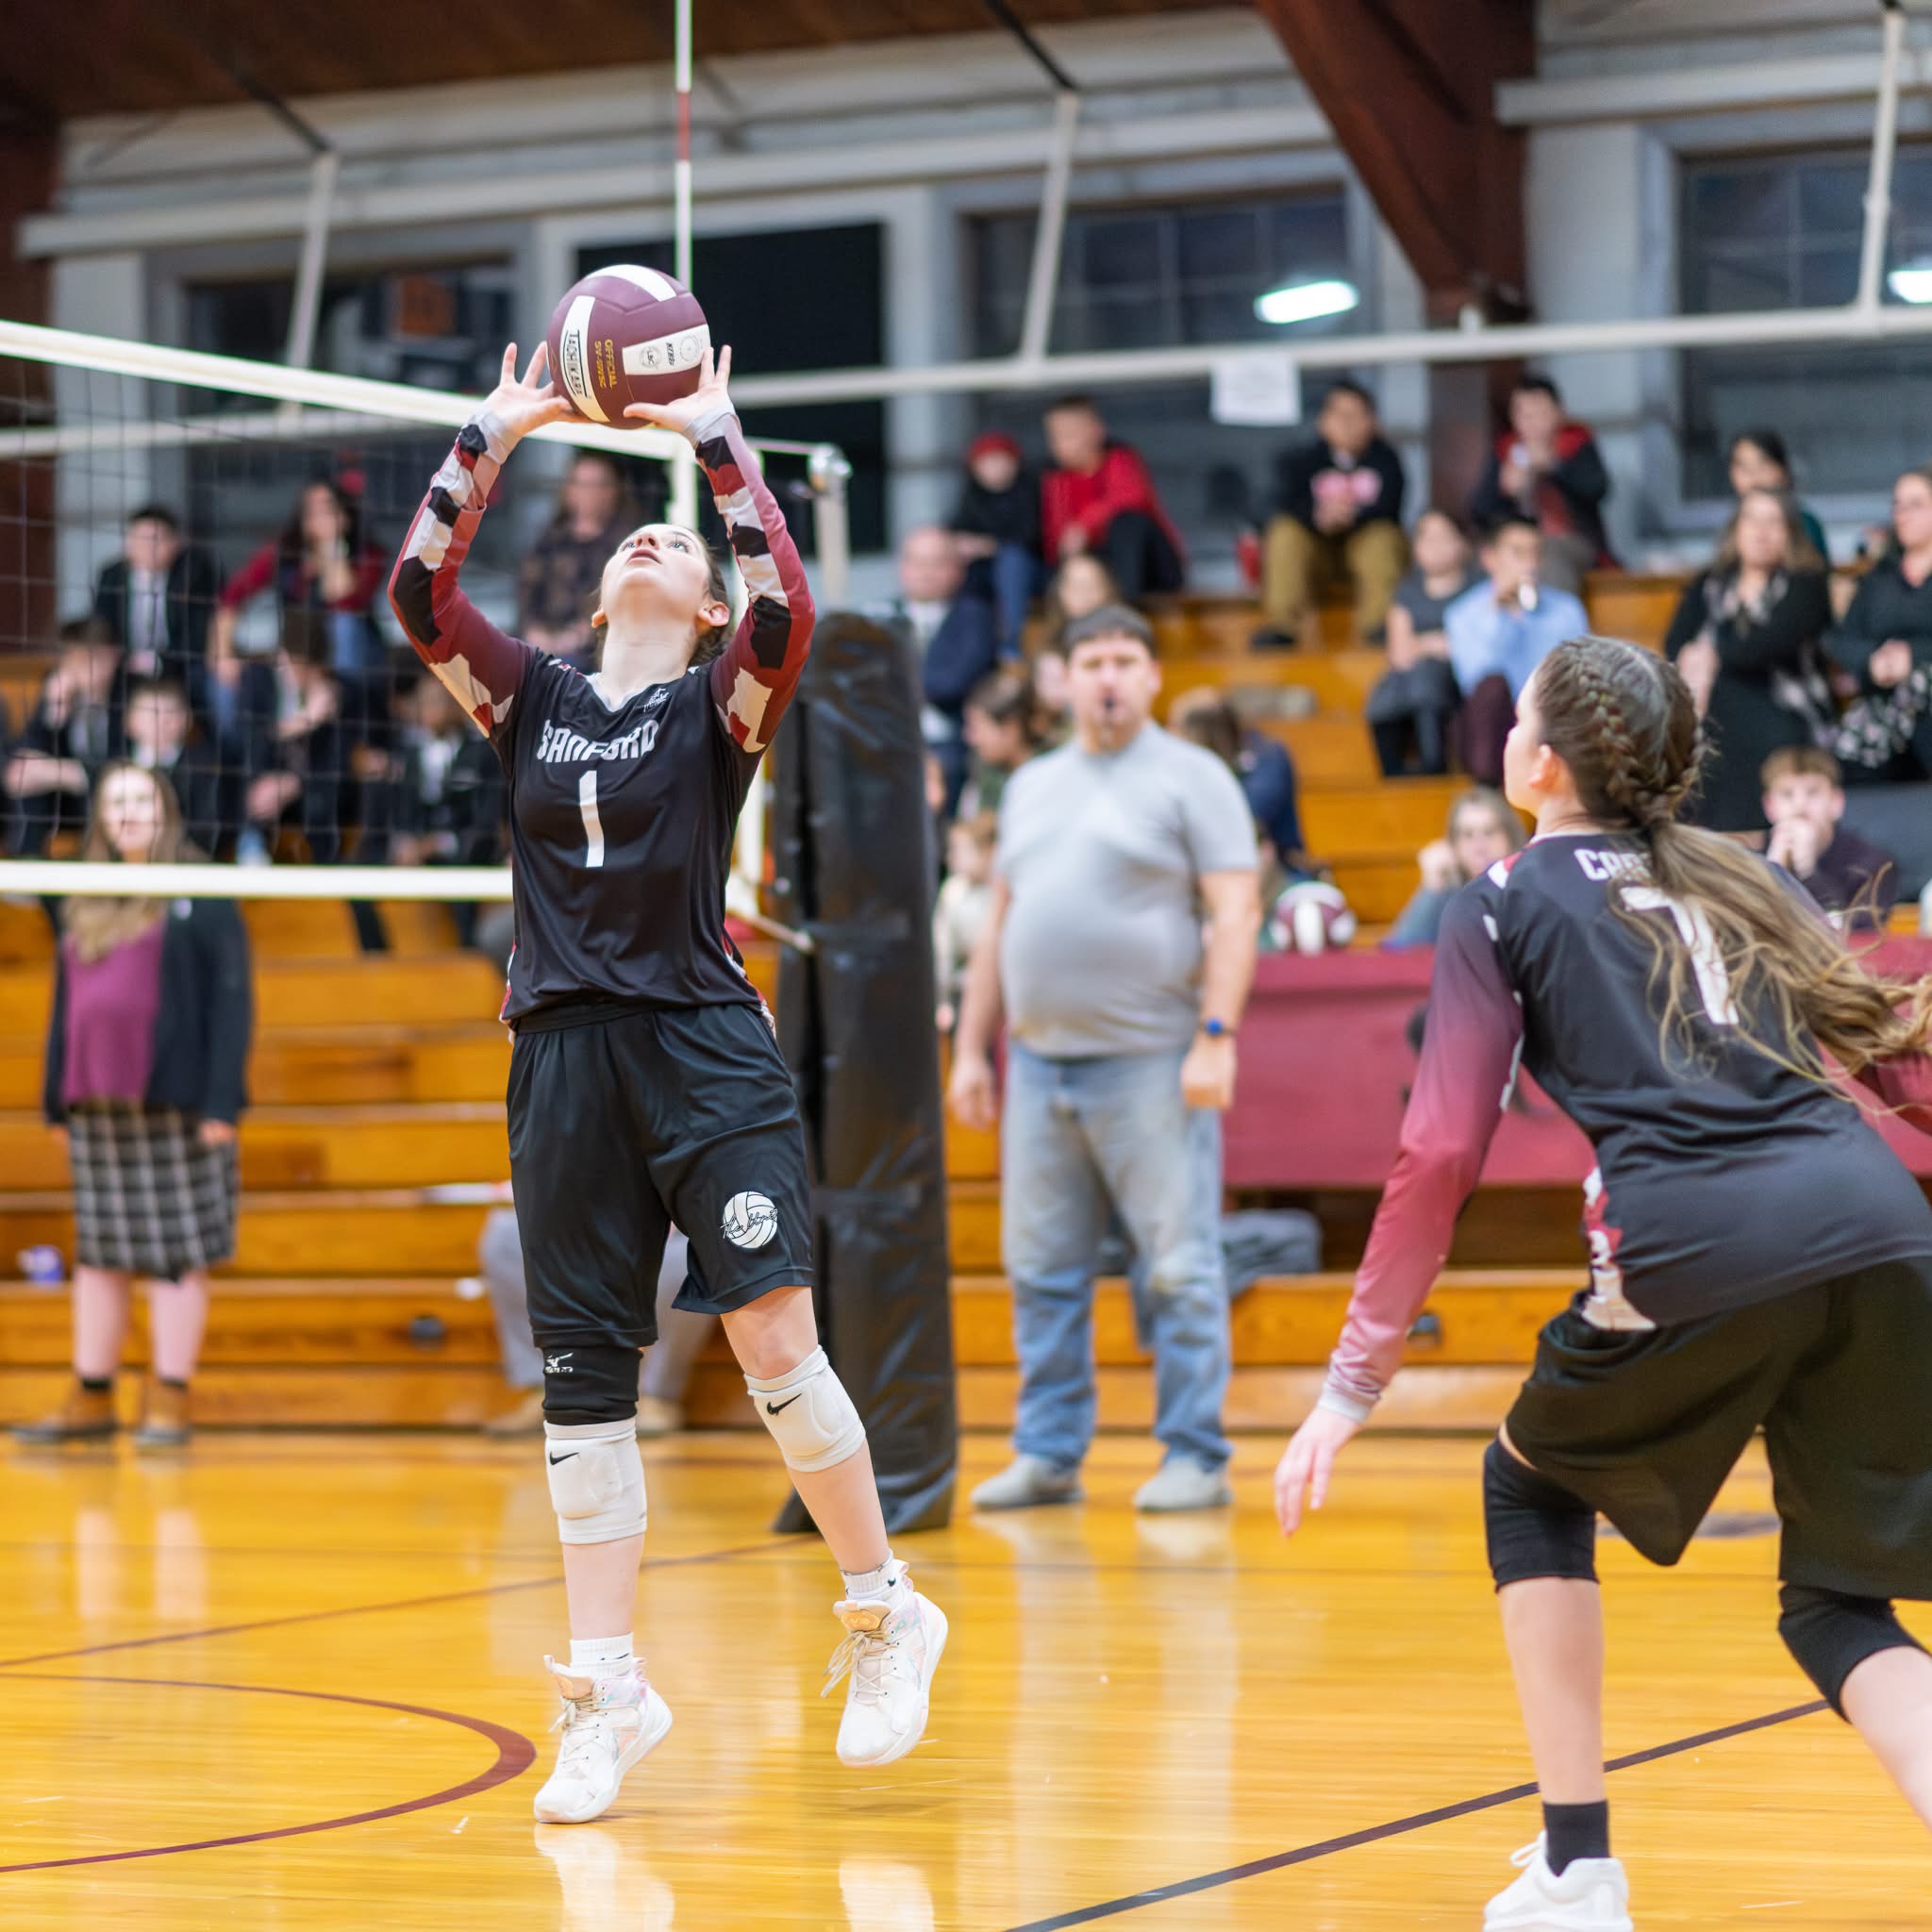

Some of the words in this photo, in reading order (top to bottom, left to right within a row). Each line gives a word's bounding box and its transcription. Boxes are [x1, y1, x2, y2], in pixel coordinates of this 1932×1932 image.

[605, 339, 618, 389] OFFICIAL
[537, 720, 659, 763] SANFORD
[579, 770, 605, 867] 1
[1619, 886, 1740, 1024] 7
